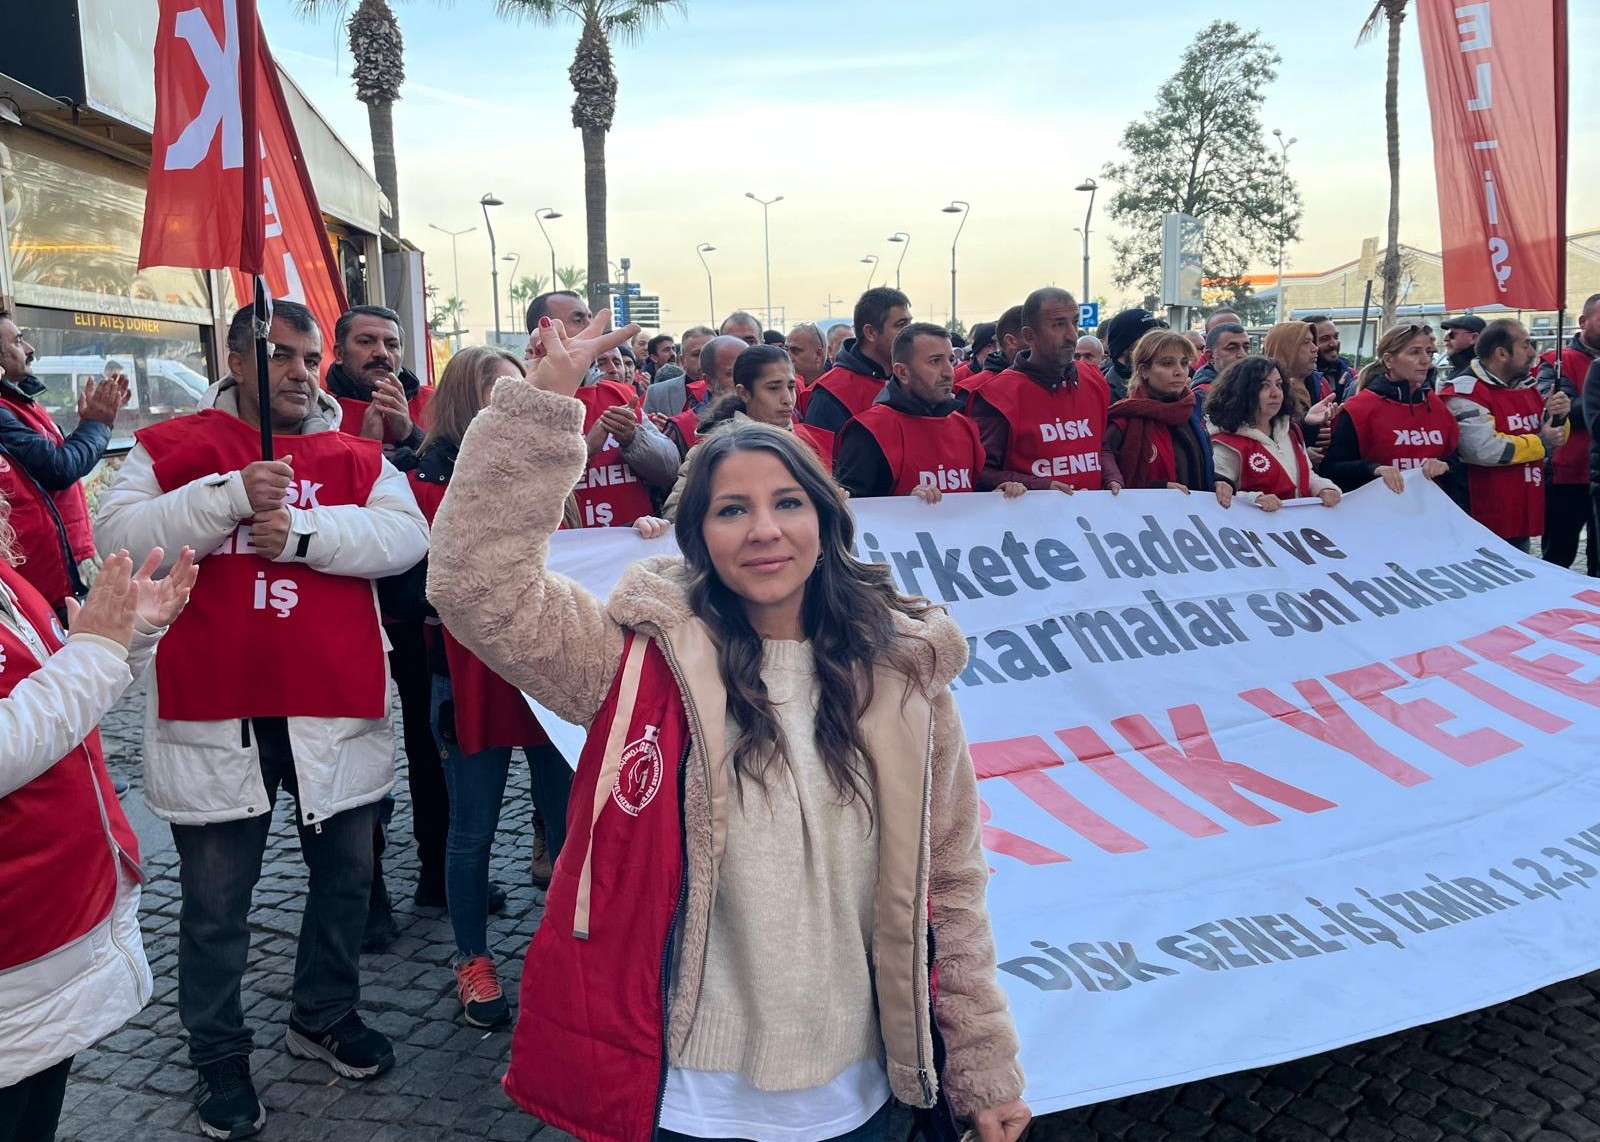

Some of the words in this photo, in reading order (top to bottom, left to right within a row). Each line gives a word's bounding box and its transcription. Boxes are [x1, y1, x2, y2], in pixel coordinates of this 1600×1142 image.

[1079, 305, 1094, 326] P
[1039, 417, 1094, 443] DİSK
[919, 464, 973, 491] DİSK
[1031, 452, 1102, 478] GENEL
[1524, 463, 1543, 487] İŞ
[585, 499, 614, 528] İŞ
[851, 530, 1087, 602] irkete
[1076, 514, 1278, 580] iadeler
[1266, 527, 1348, 566] ve
[254, 571, 299, 618] İŞ
[950, 589, 1250, 691] karmalar
[1246, 588, 1362, 638] son
[1327, 546, 1536, 618] bulsun!
[997, 940, 1181, 992] DİSK
[1156, 896, 1406, 972] GENEL-İŞ
[1355, 872, 1520, 934] İZMİR
